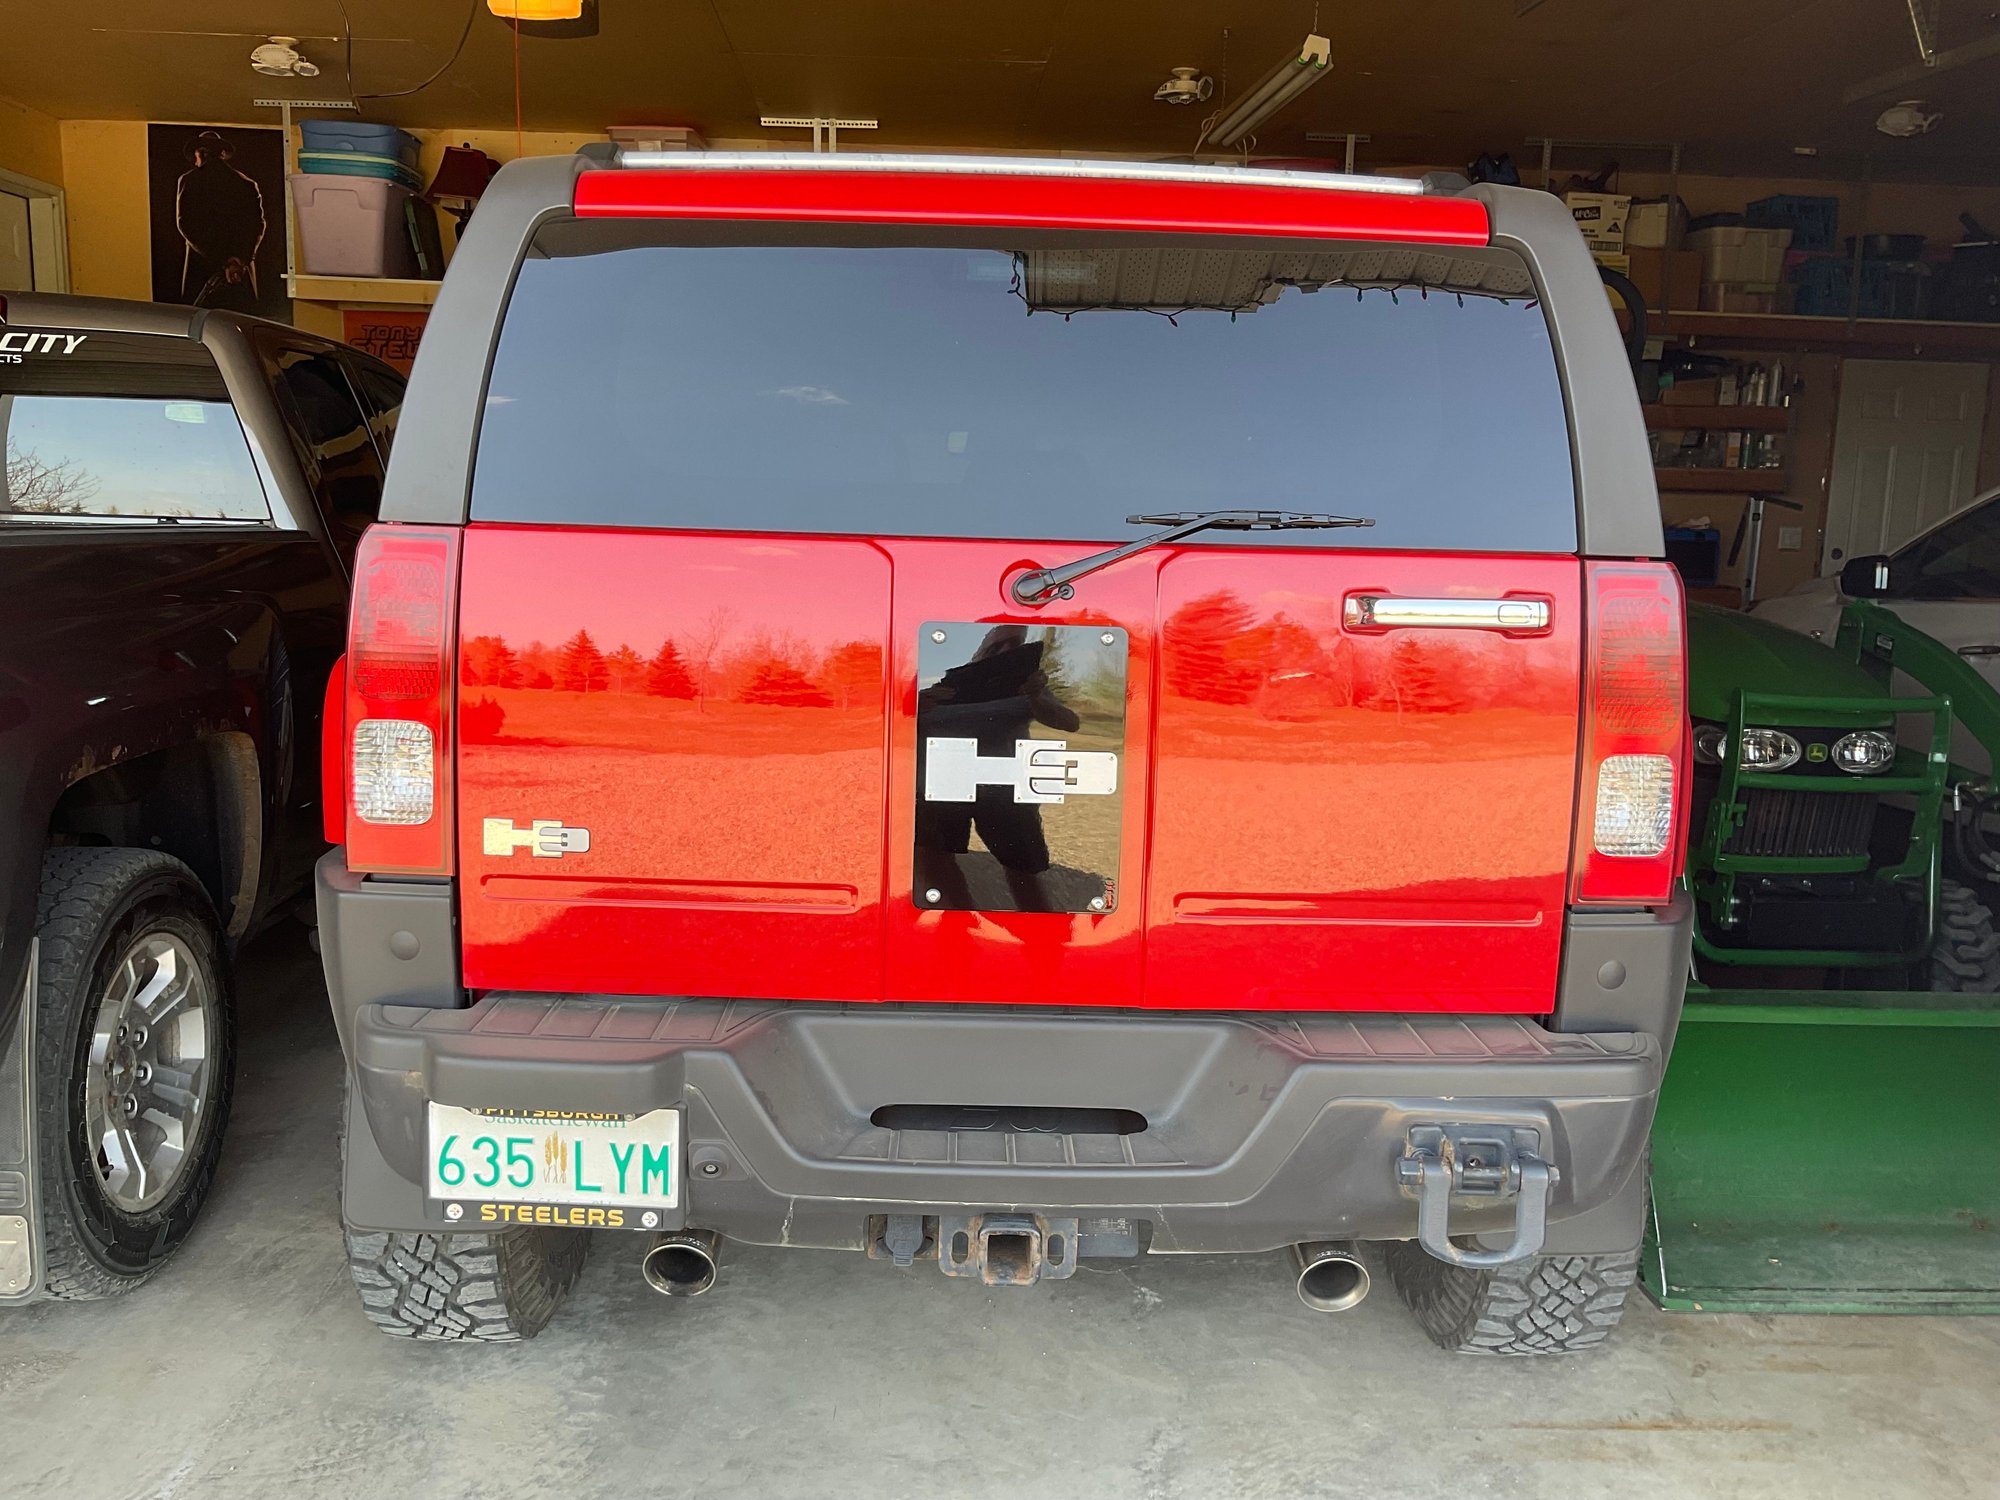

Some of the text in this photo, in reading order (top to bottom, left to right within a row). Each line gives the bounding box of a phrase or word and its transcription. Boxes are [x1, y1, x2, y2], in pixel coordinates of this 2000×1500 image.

[0, 332, 87, 354] CITY
[361, 325, 422, 341] TONY
[438, 1135, 671, 1196] 635 LYM
[480, 1204, 624, 1227] STEELERS
